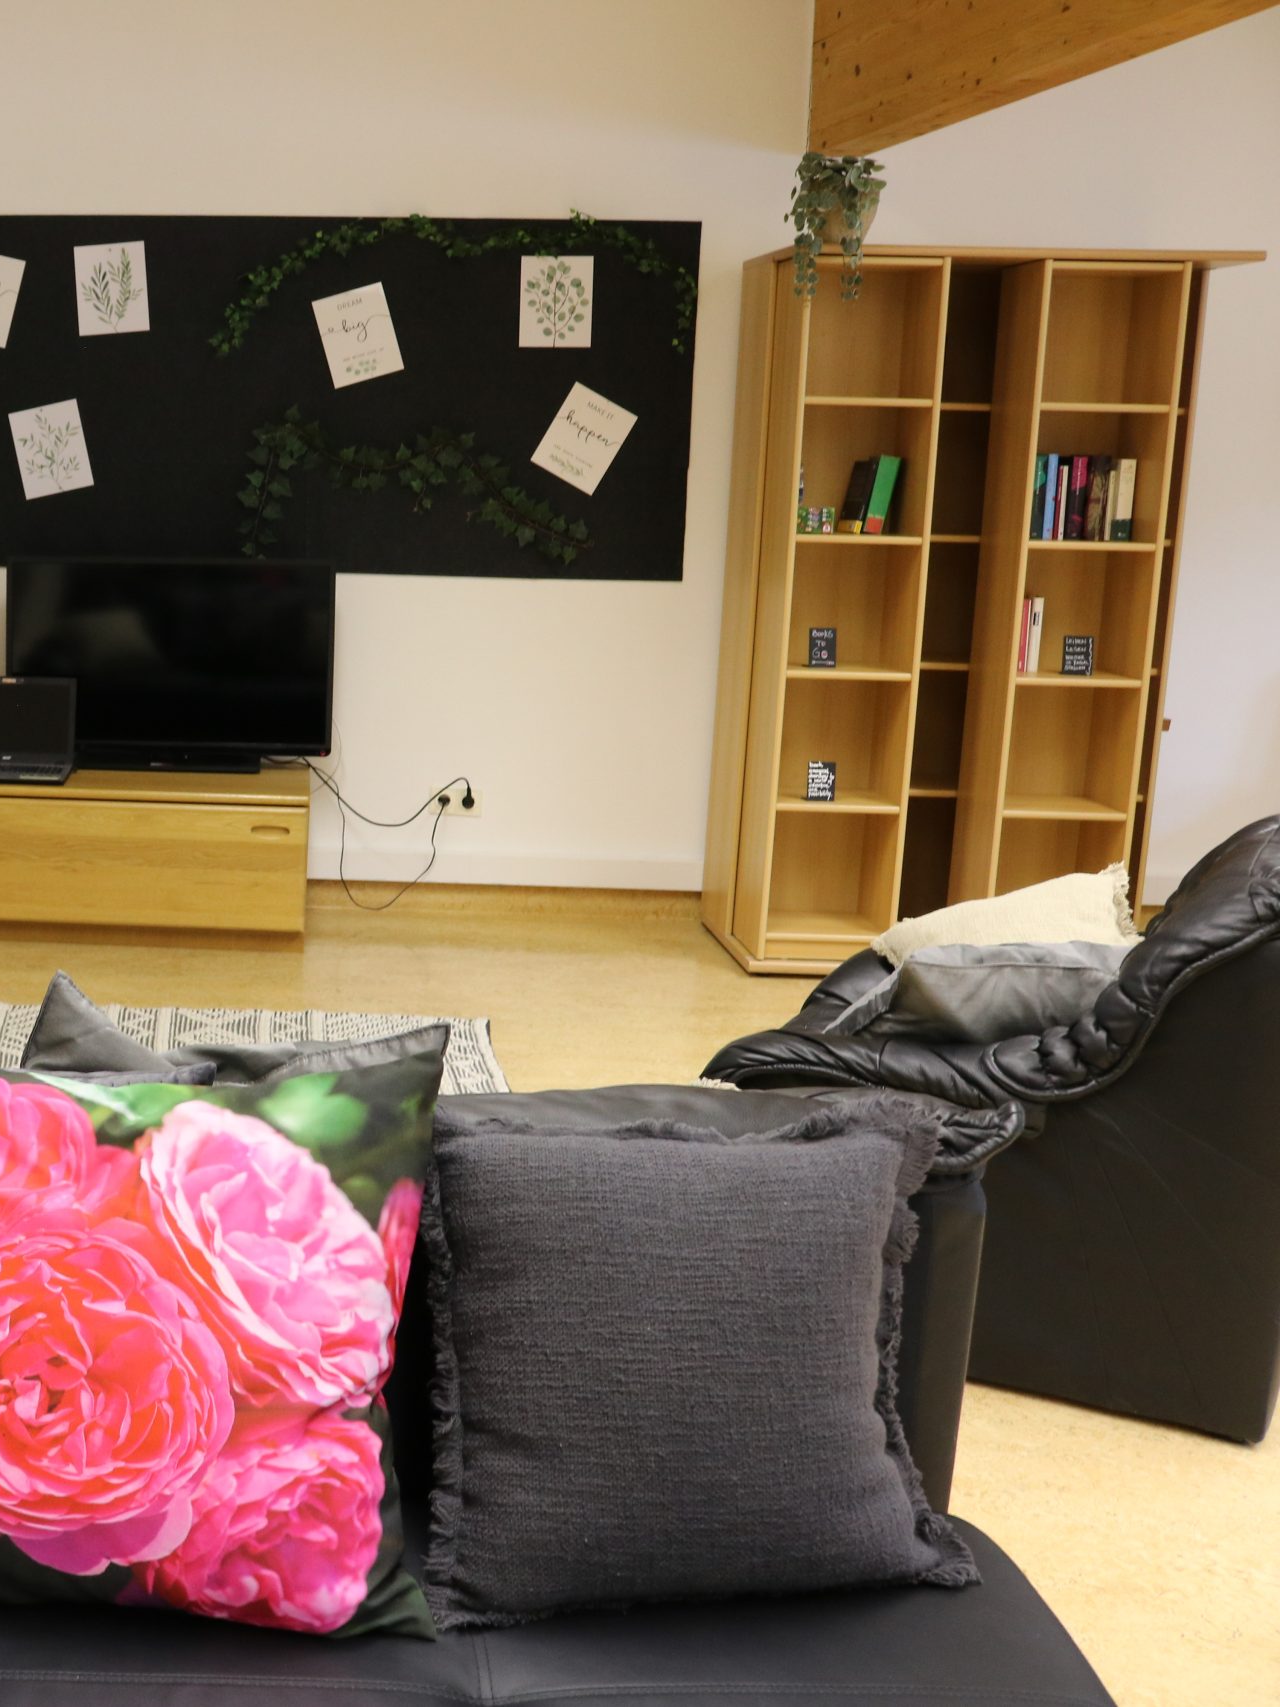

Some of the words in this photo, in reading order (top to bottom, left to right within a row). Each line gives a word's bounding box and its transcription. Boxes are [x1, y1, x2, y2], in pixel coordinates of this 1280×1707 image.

[337, 297, 363, 311] DREAM
[341, 318, 373, 343] big
[586, 401, 605, 417] MAKE
[565, 408, 612, 447] happen
